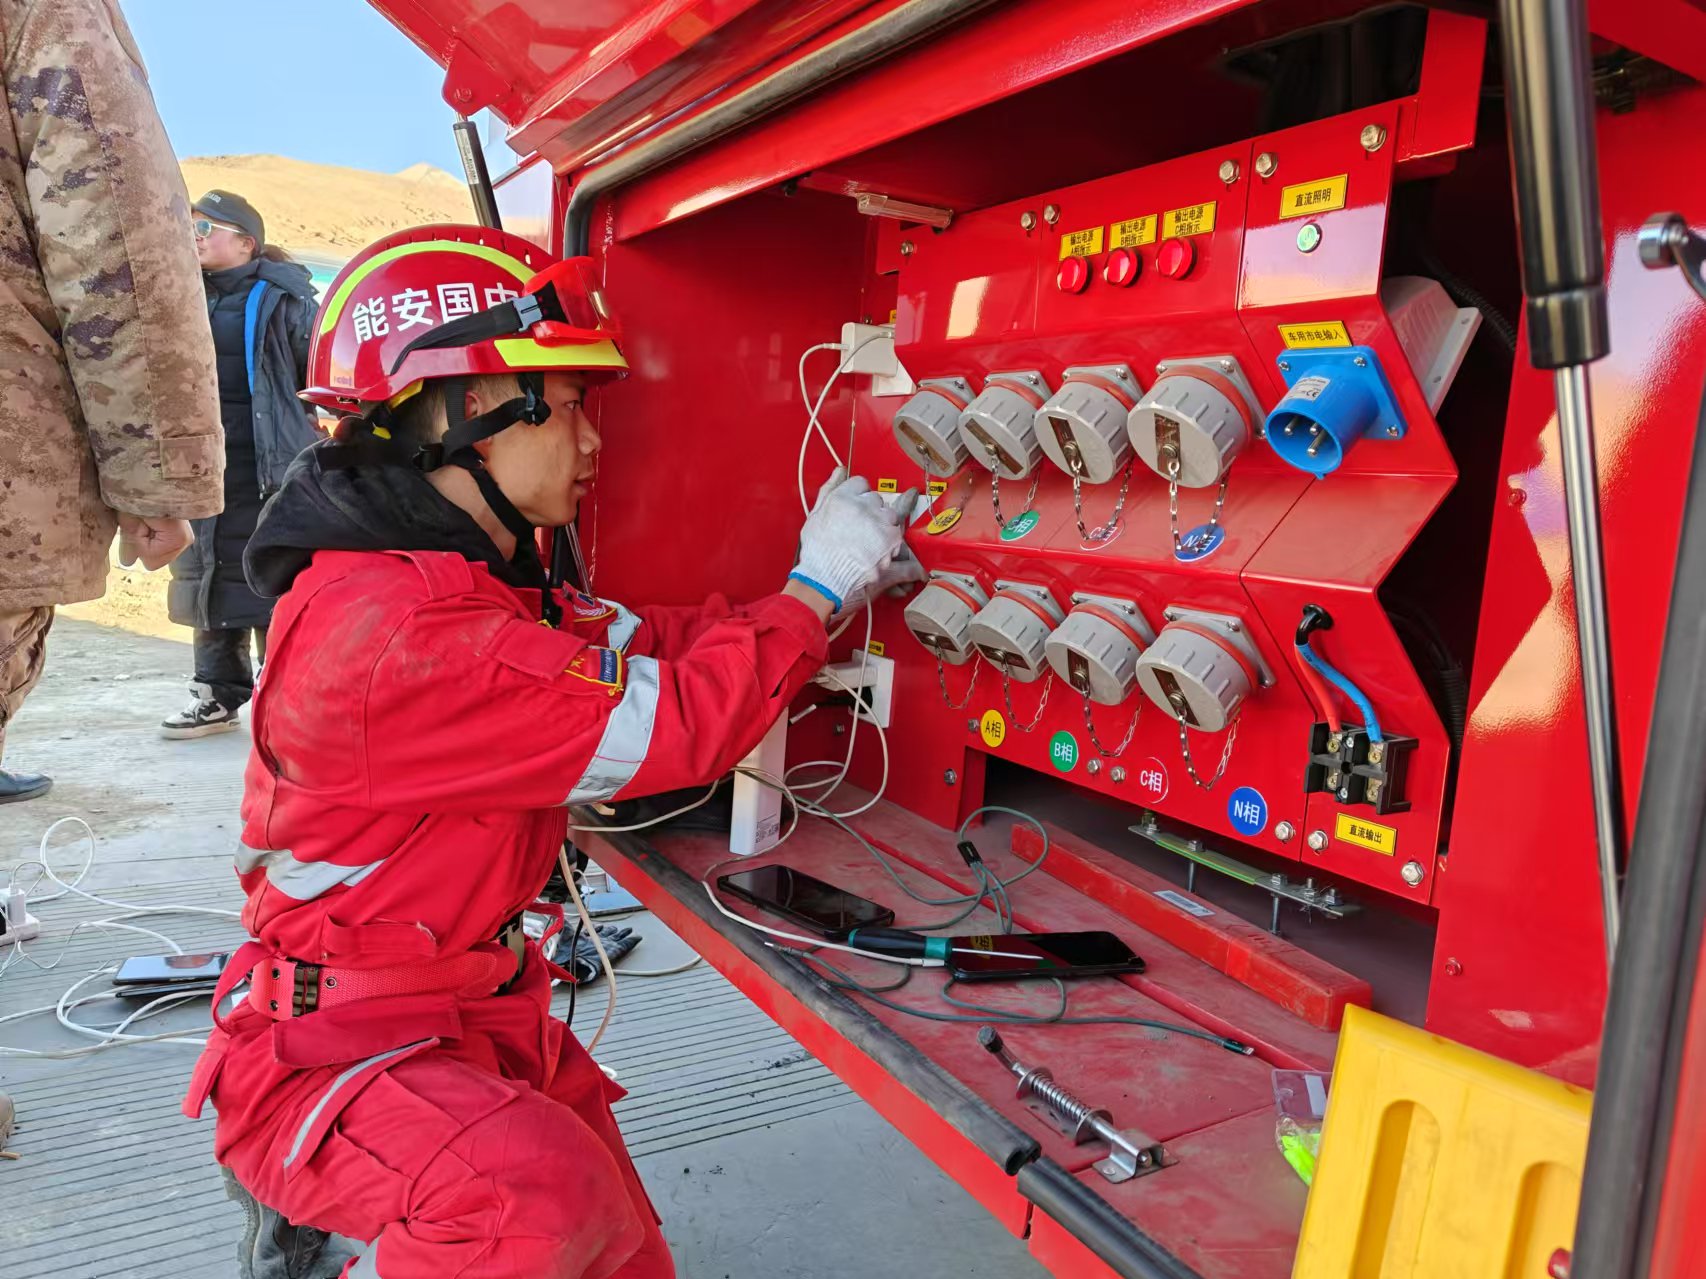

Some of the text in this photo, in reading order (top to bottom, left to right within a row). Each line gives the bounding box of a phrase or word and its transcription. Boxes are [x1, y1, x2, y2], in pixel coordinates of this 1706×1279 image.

[1295, 188, 1331, 207] 直流照明
[1175, 205, 1204, 223] 输出电源
[1120, 218, 1146, 235] 输出电源
[1071, 230, 1094, 246] 输出电源
[1288, 328, 1344, 342] 车用市电输入
[985, 720, 1001, 739] A相
[1054, 742, 1073, 763] B相
[1140, 770, 1163, 793] C相
[1234, 800, 1260, 826] N相
[1349, 824, 1383, 844] 直流输出
